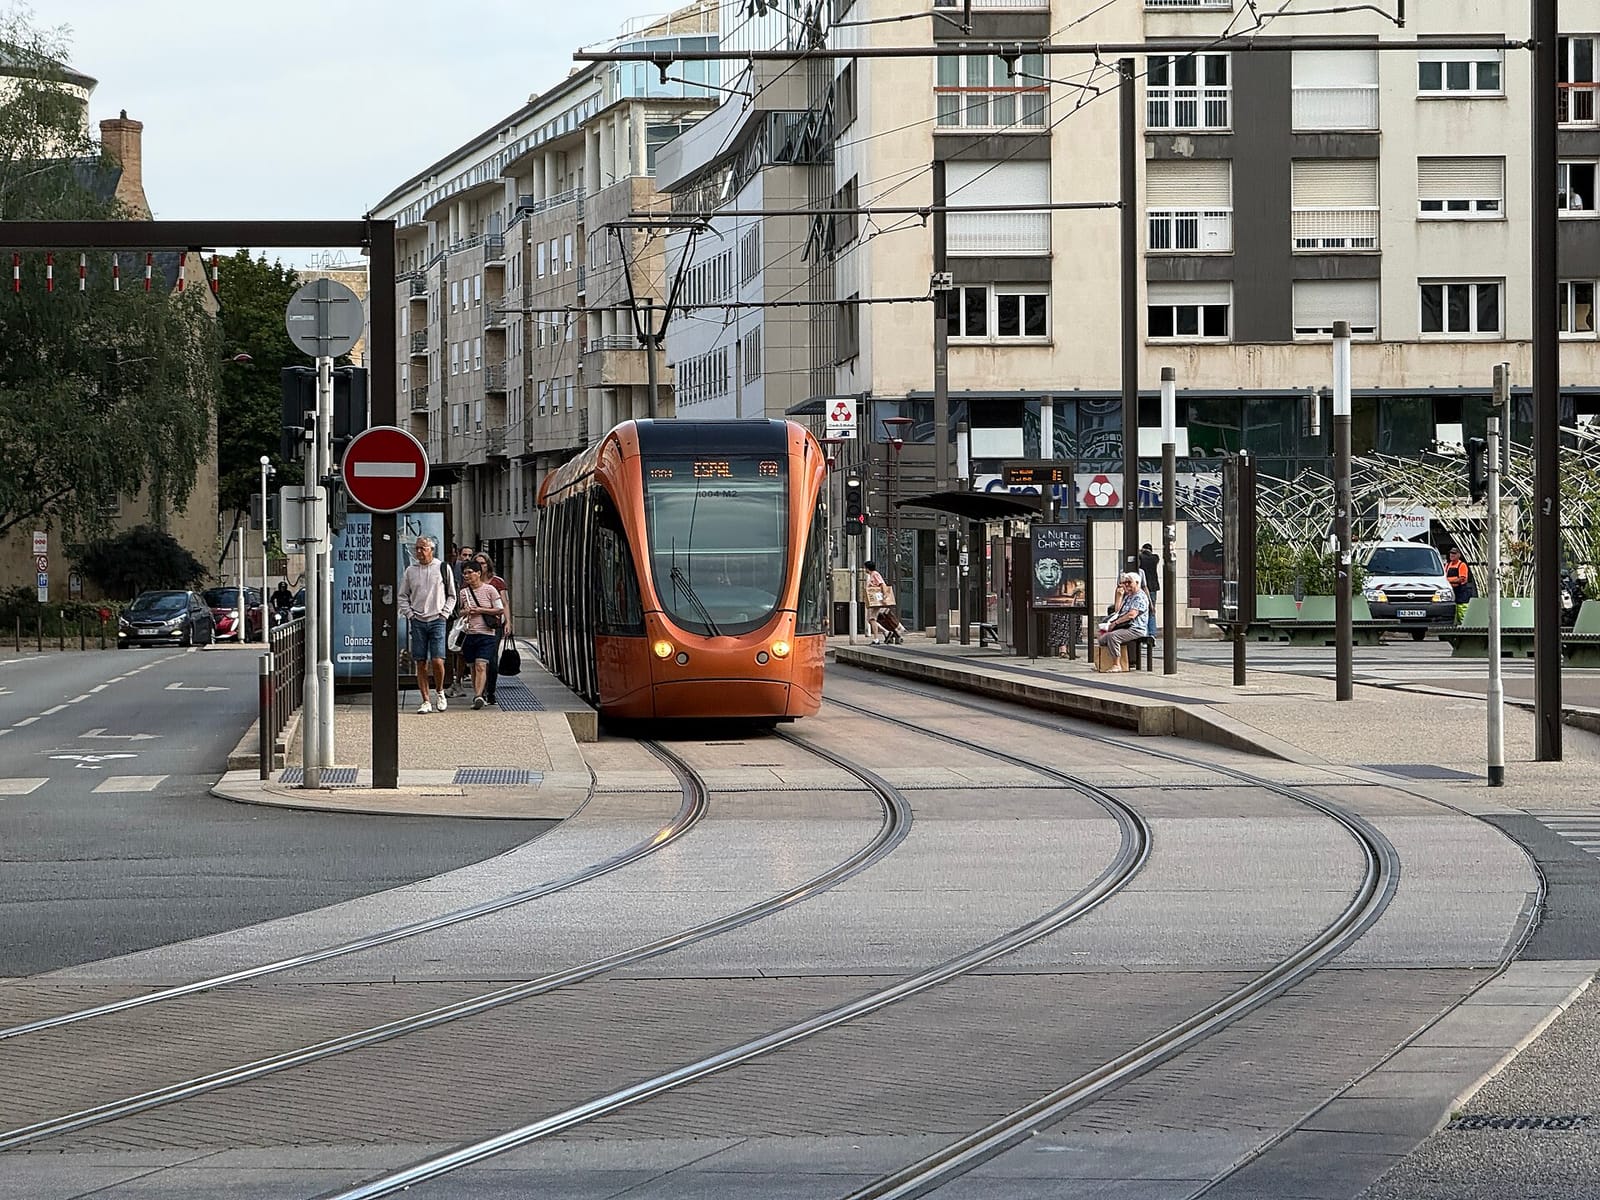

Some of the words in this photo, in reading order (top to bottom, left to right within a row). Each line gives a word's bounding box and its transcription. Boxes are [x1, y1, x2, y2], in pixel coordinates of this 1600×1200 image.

[347, 523, 355, 534] UN
[358, 523, 370, 534] ENF
[352, 535, 371, 547] L'HÔP
[338, 550, 347, 560] NE
[354, 563, 372, 574] COMM
[348, 576, 361, 587] PAR
[362, 576, 372, 587] MA
[341, 589, 358, 600] MAIS
[359, 589, 368, 600] LA
[342, 602, 360, 614] PEUT
[362, 602, 372, 614] L'A
[345, 635, 372, 646] Donnez
